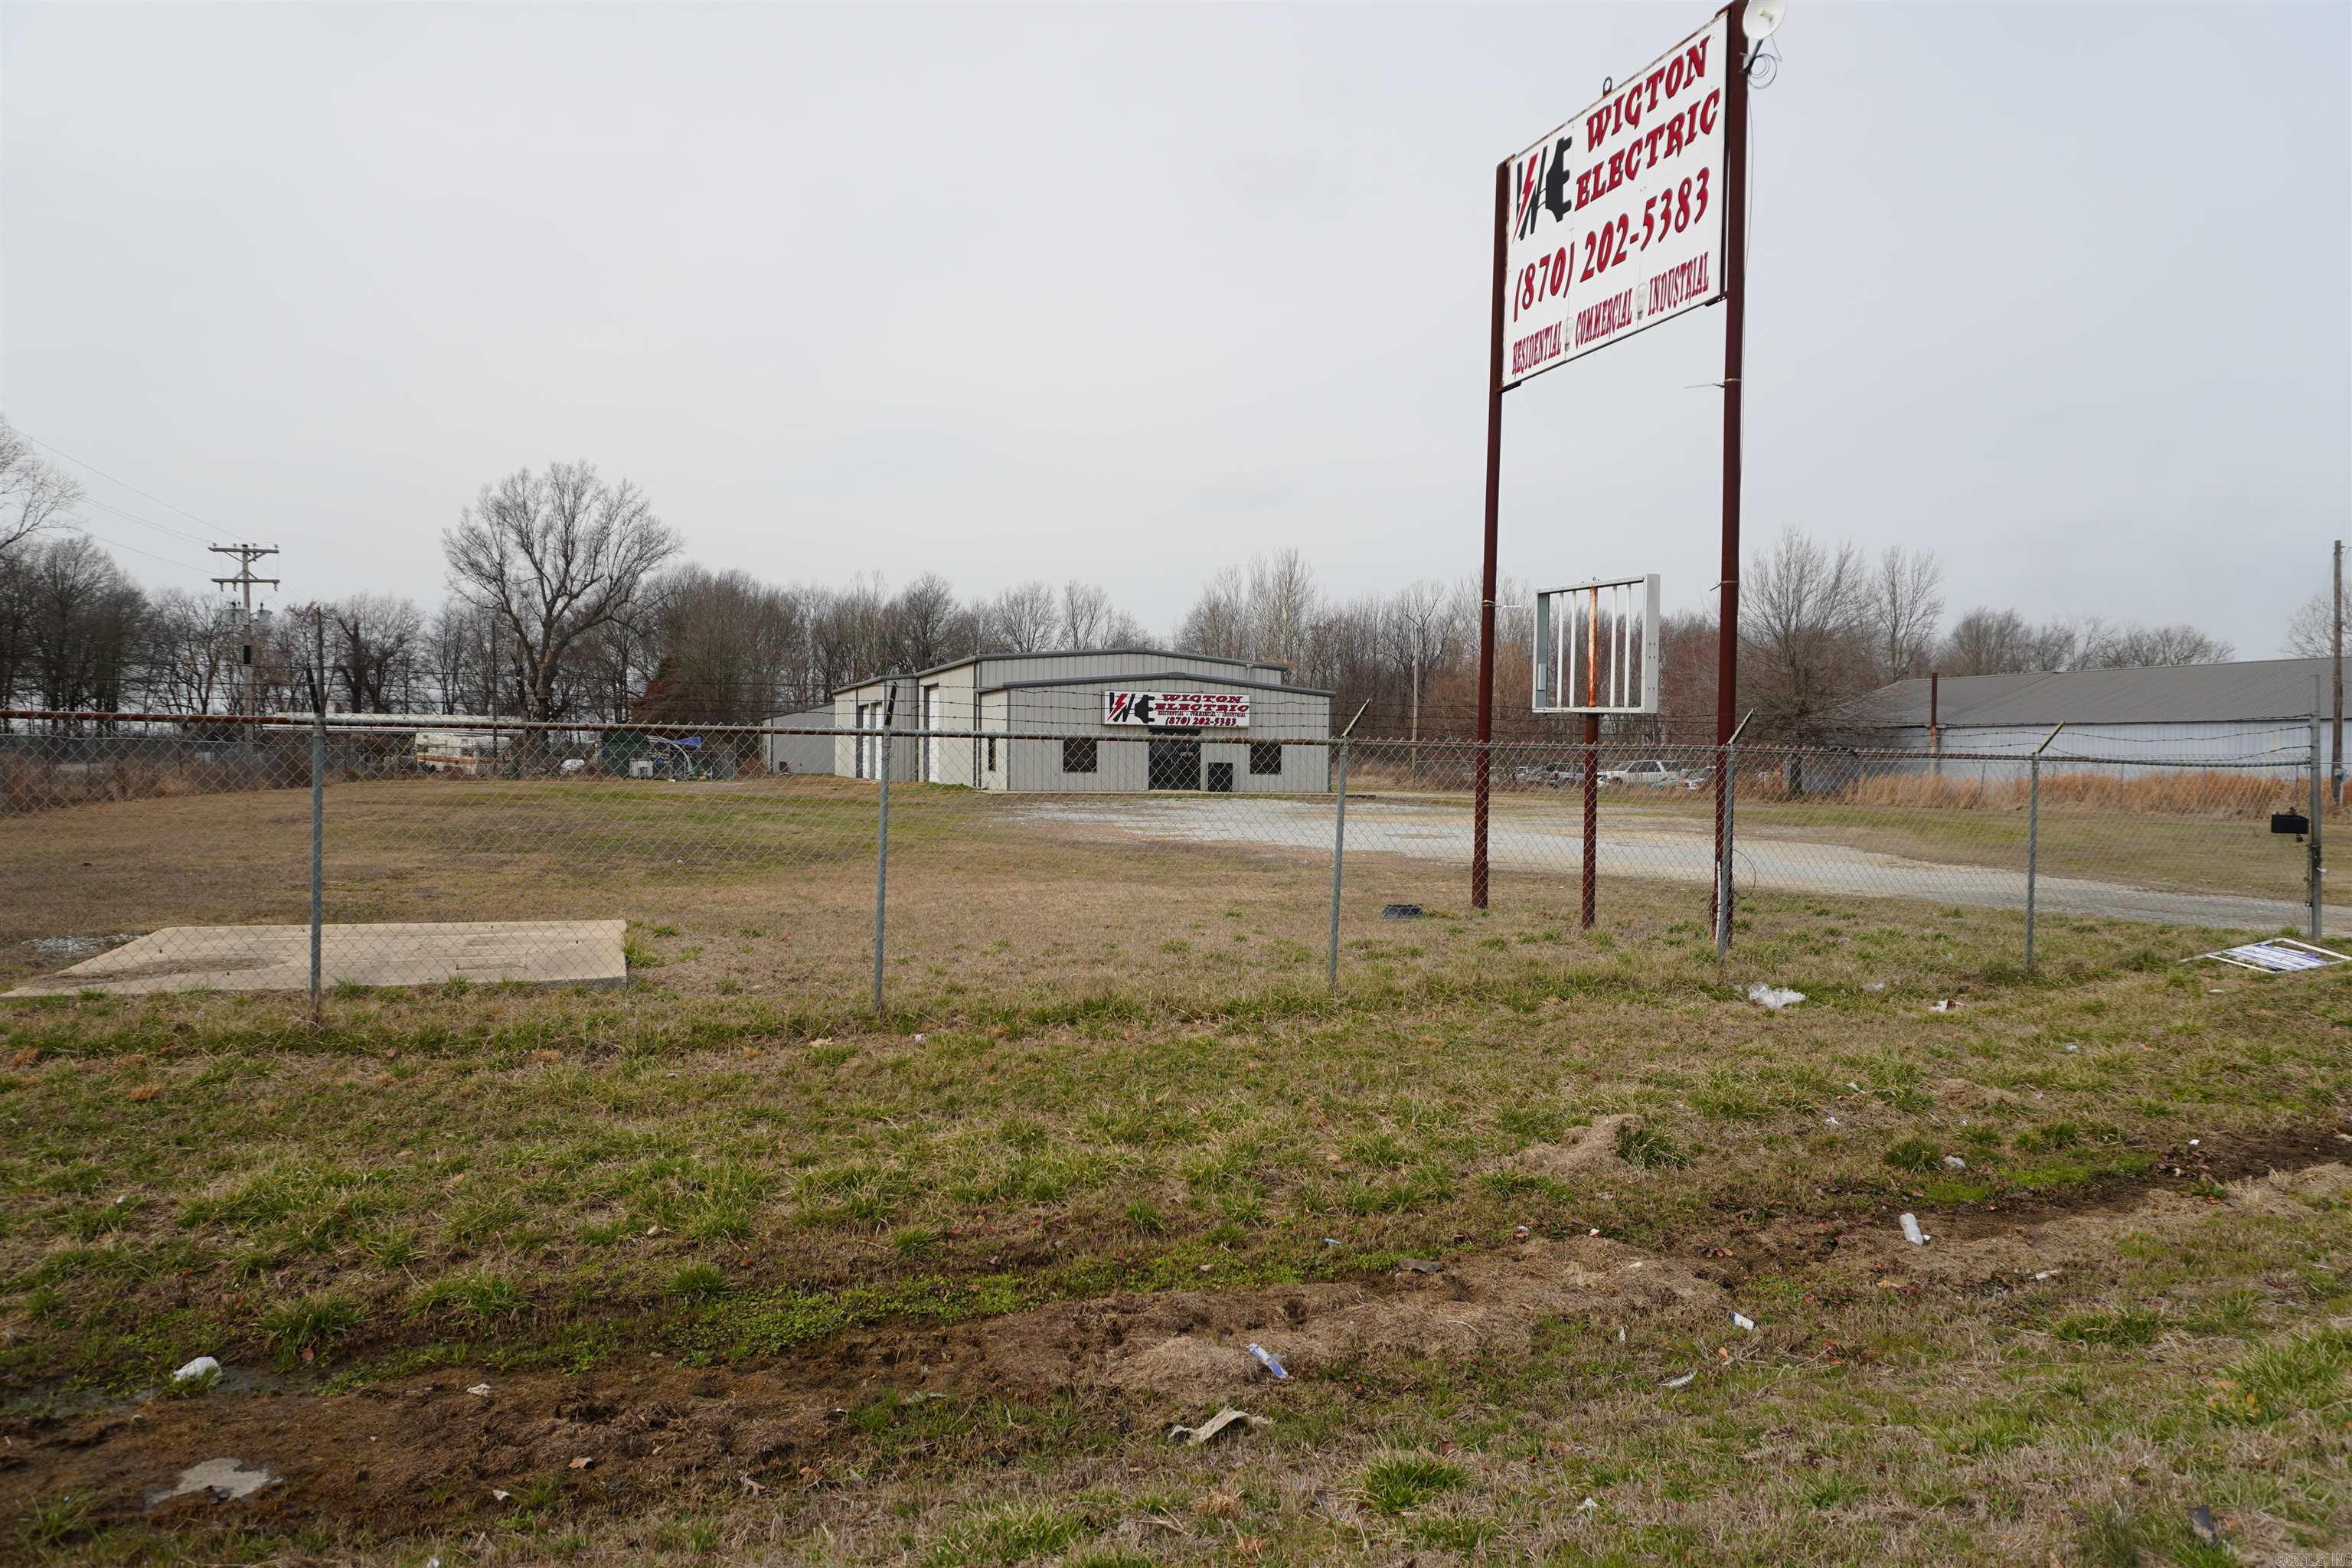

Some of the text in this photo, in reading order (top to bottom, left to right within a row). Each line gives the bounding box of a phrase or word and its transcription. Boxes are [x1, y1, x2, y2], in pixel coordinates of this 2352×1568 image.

[1574, 87, 1720, 212] ELECTRIC
[1586, 34, 1711, 153] WIGTON
[1514, 166, 1710, 322] (870) 202-5383
[1511, 251, 1709, 375] RESIDENTIAL COMMERCIAL INDUSTRIAL
[1155, 703, 1250, 713] ELECTRIC
[1162, 694, 1243, 703] WIGTON
[1165, 717, 1237, 726] (870) 202-5383
